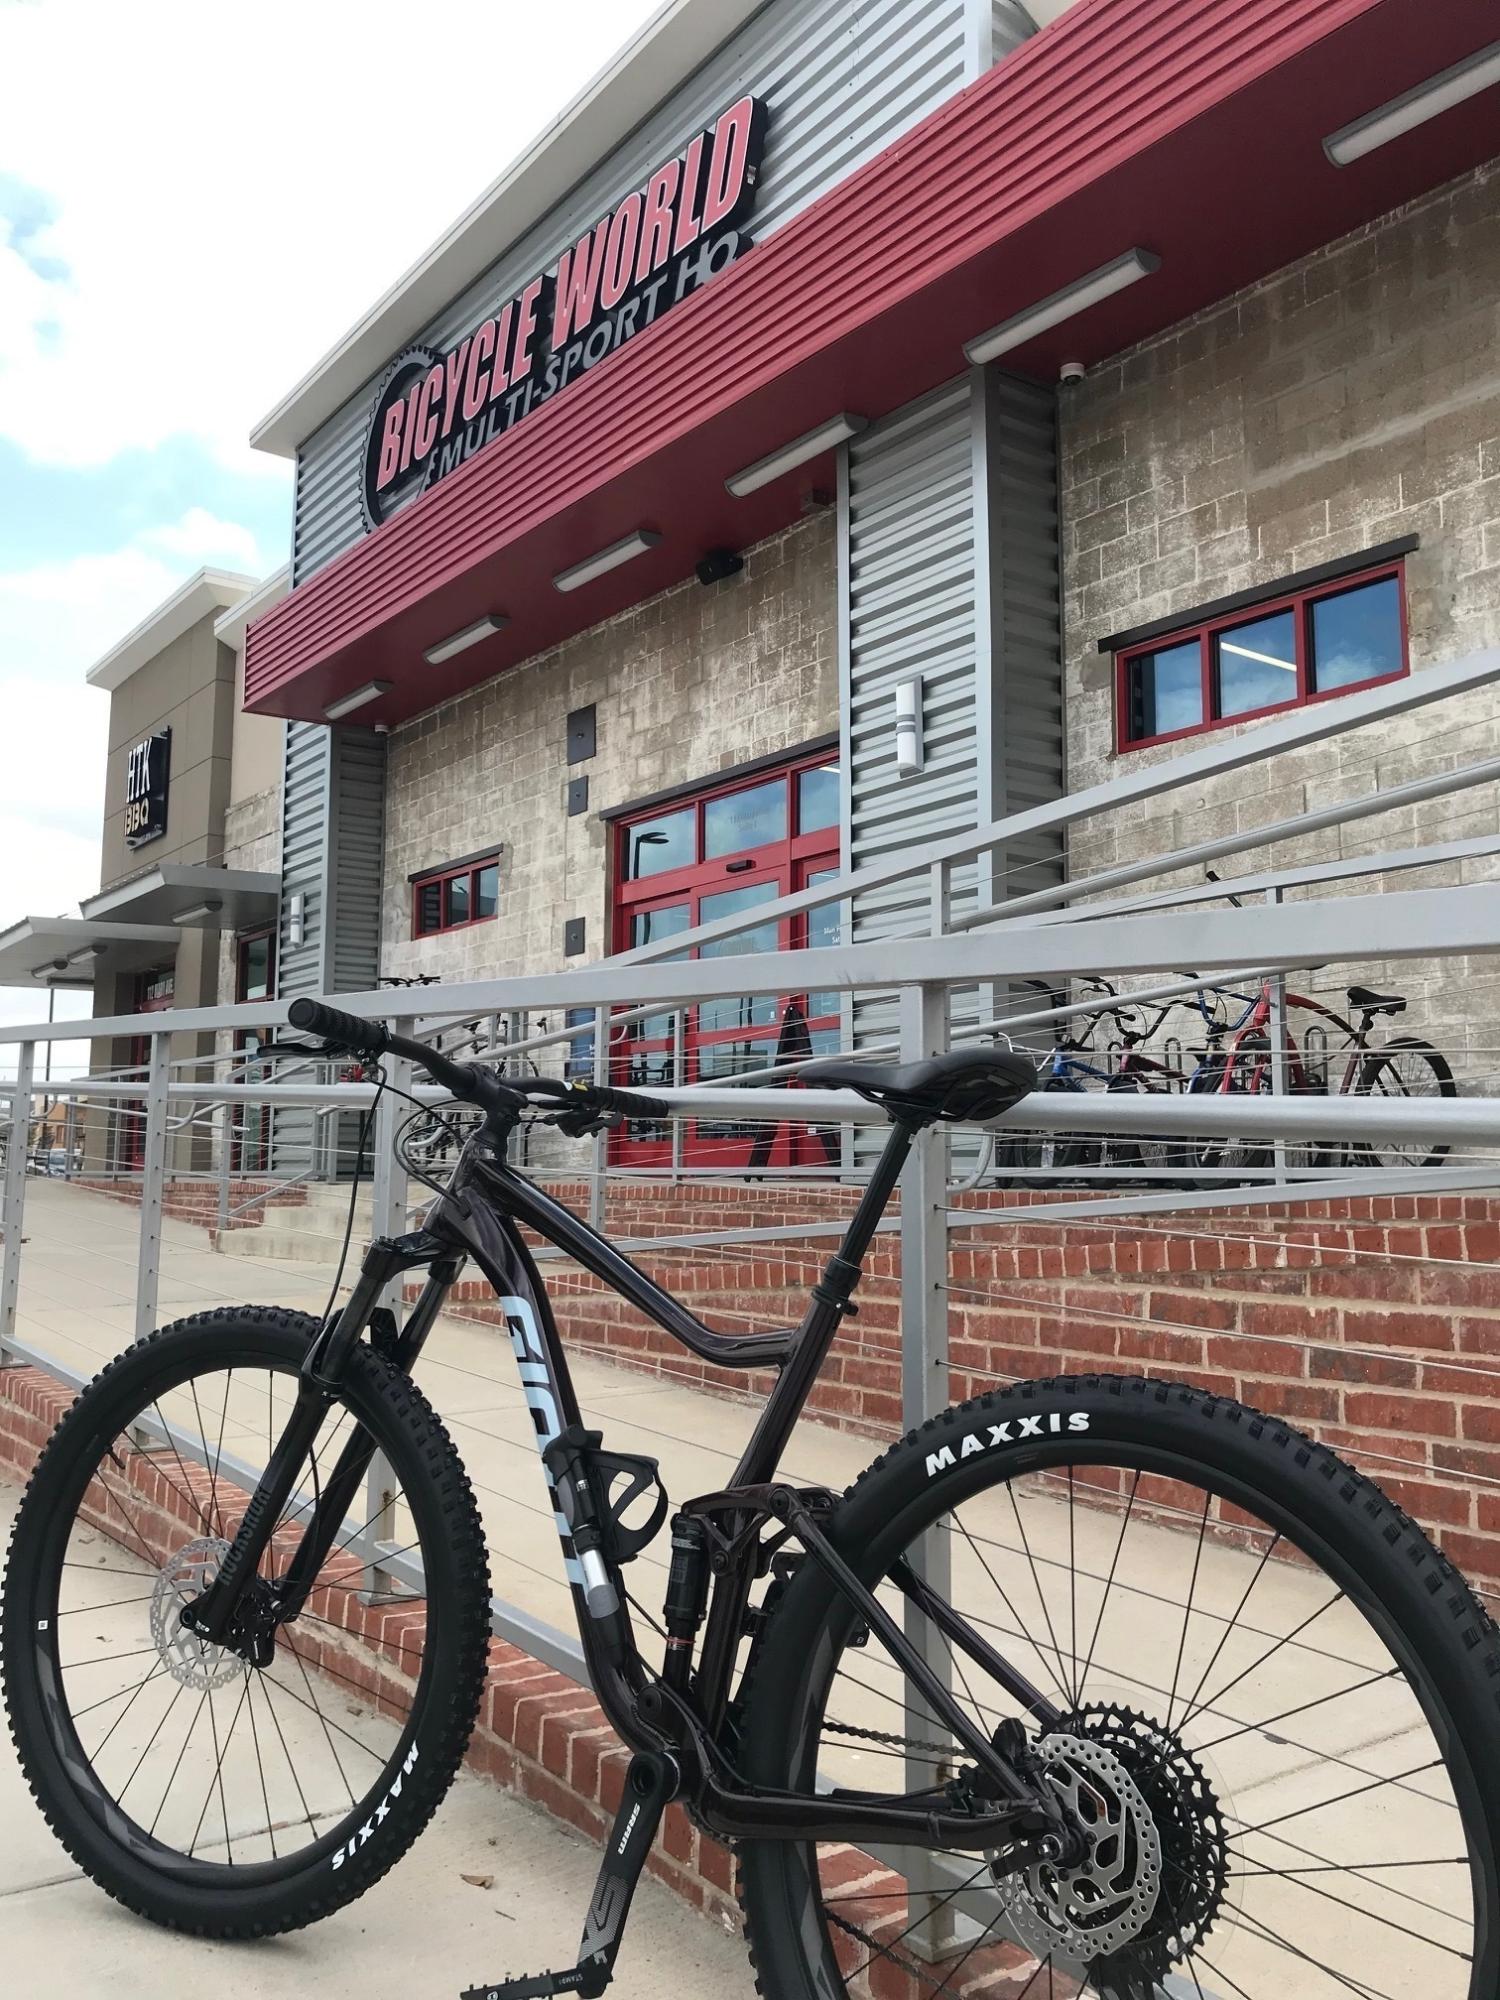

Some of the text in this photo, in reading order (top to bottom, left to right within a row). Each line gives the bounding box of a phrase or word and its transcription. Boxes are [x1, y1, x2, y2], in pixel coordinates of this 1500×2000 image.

[376, 94, 754, 492] BICYCLE WORLD
[438, 272, 668, 481] MULTI-SPORT
[126, 736, 152, 804] HTK
[124, 797, 149, 836] BBQ
[925, 1412, 1090, 1477] MAXXIS
[332, 1739, 419, 1870] MAXXIS
[617, 1802, 641, 1855] SRAM
